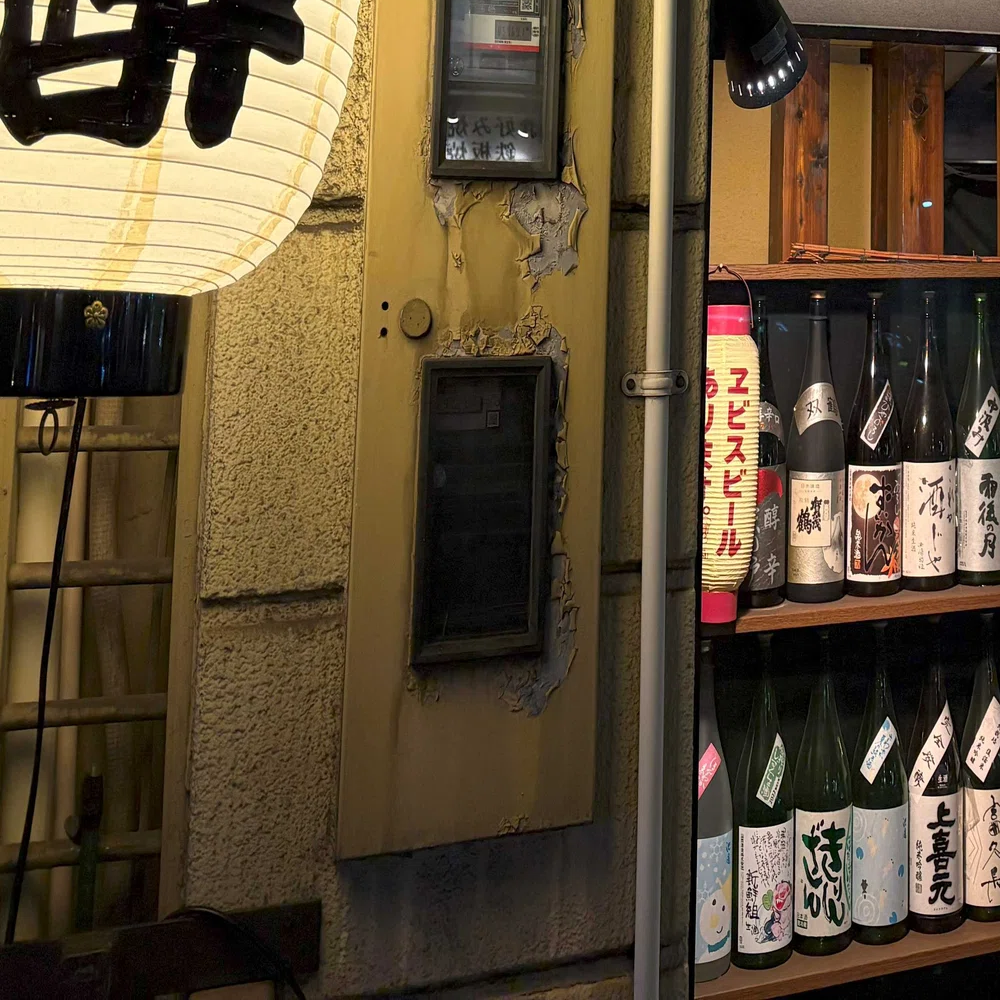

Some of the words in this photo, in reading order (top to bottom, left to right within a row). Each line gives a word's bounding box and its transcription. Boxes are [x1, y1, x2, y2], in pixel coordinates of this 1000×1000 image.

[978, 472, 1000, 560] 雨後の月
[926, 801, 956, 905] 上喜元
